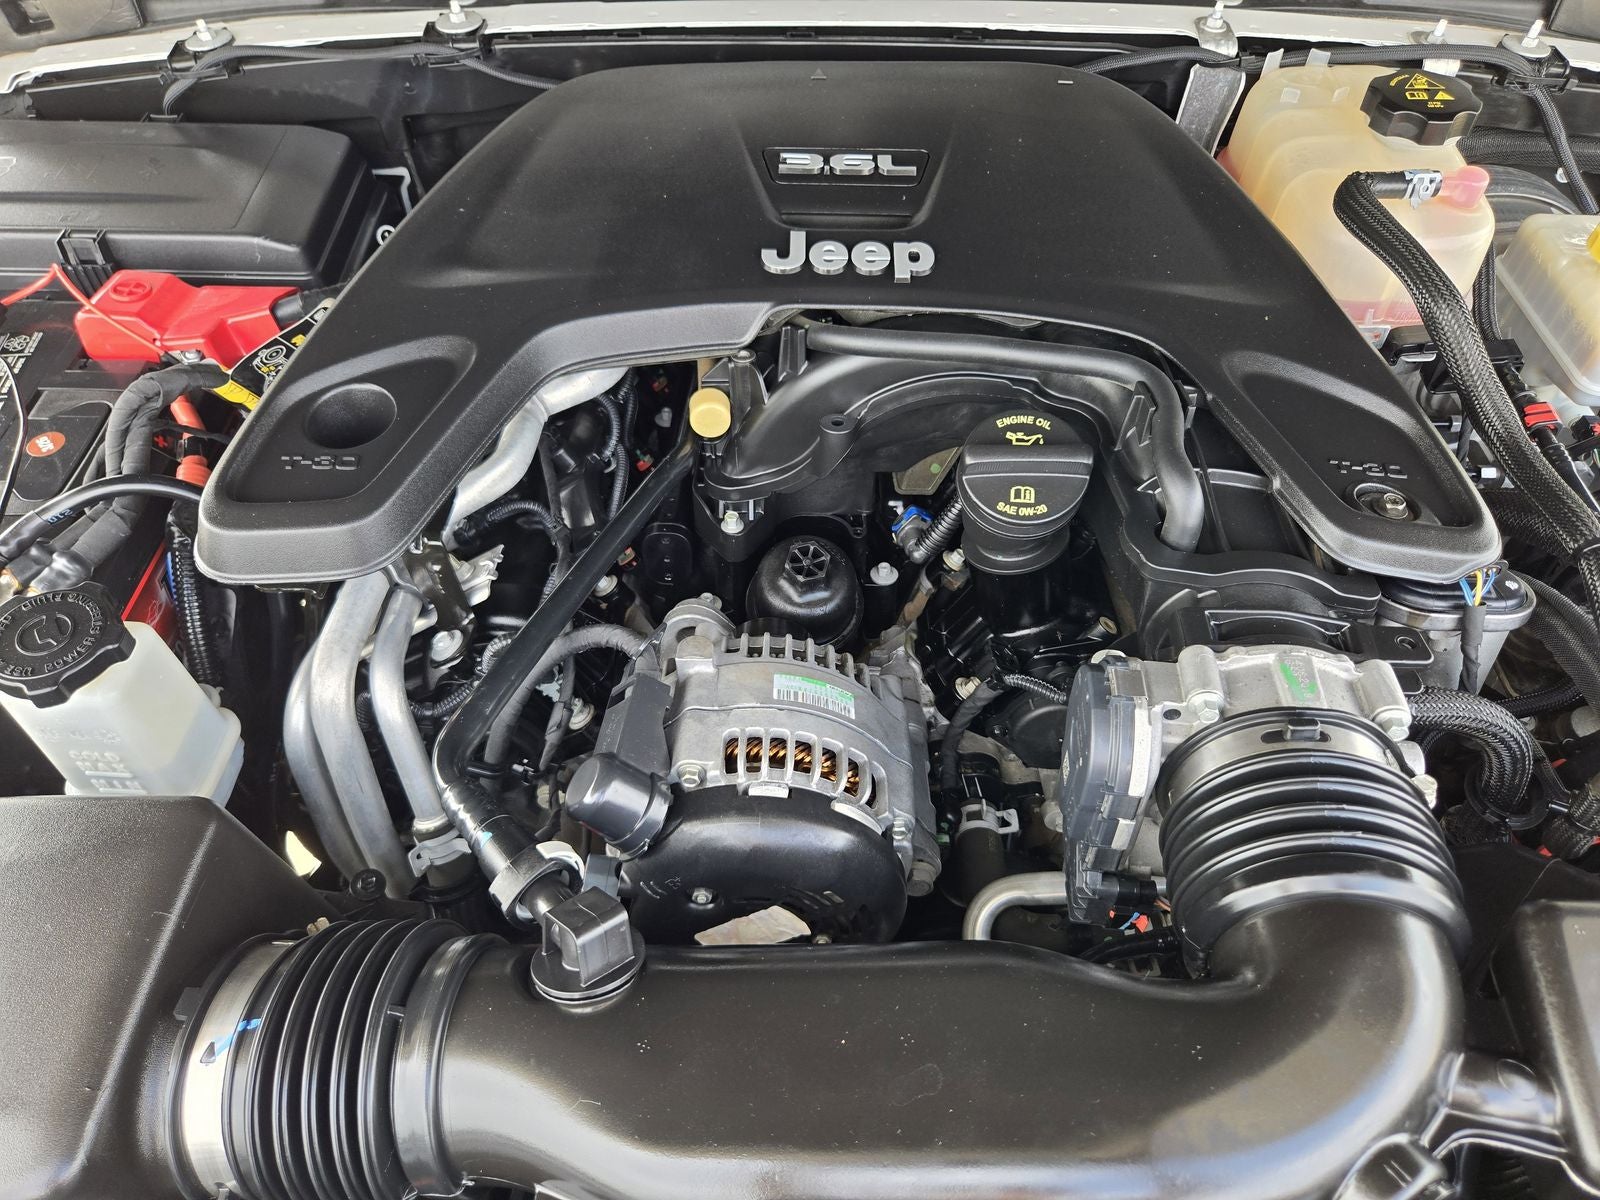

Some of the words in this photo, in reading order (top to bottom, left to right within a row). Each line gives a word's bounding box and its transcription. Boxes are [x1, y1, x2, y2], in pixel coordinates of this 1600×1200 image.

[778, 153, 917, 176] 3.6L
[761, 230, 936, 284] Jeep
[995, 415, 1035, 429] ENGINE
[1035, 417, 1052, 431] OIL
[280, 455, 359, 471] T-30
[996, 501, 1018, 516] SAE
[1018, 503, 1049, 516] 0W-20
[21, 592, 64, 612] FLUID
[66, 592, 104, 636] STEERING
[43, 634, 96, 674] POWER
[4, 663, 33, 677] USE
[68, 750, 120, 762] COLD
[75, 760, 130, 773] MAX
[90, 778, 143, 790] MIN
